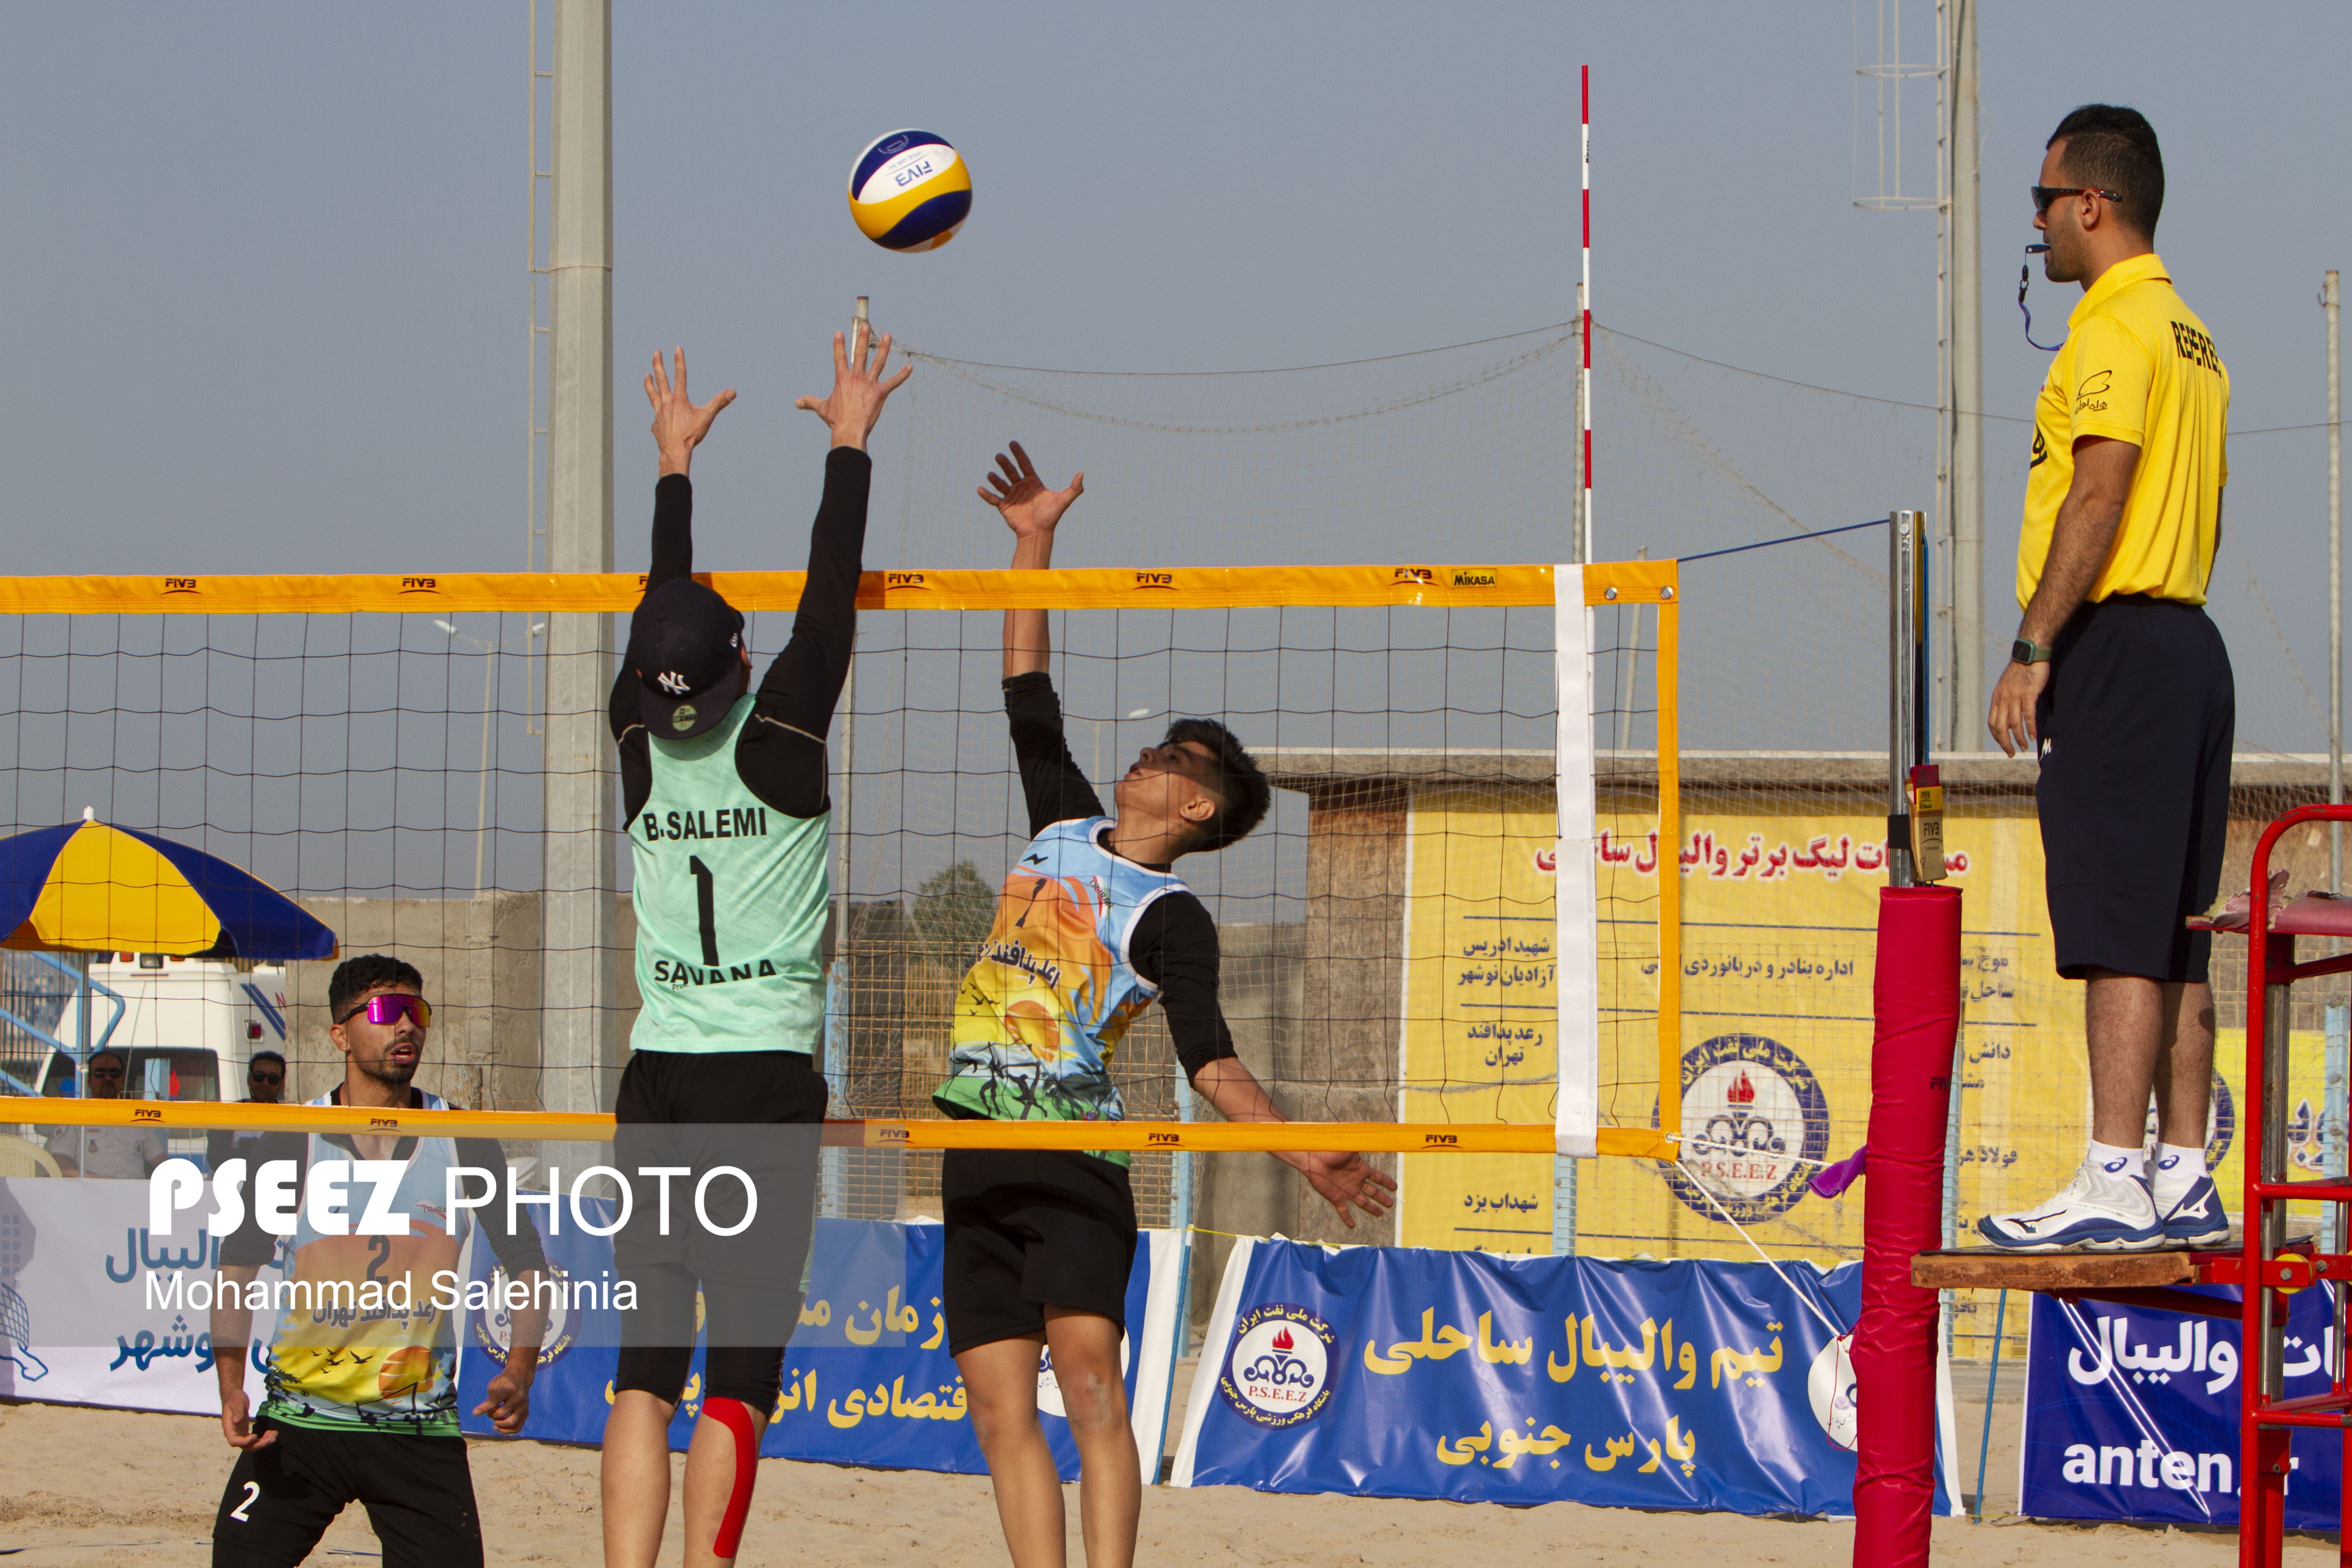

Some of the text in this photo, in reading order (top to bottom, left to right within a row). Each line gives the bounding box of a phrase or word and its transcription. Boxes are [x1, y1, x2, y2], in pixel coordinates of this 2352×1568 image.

[166, 578, 196, 588] FIVB
[402, 578, 436, 588] FIVB
[888, 573, 924, 583] FIVB
[1137, 573, 1172, 583] FIVB
[1394, 568, 1432, 579] FIVB
[643, 807, 767, 842] B.SALEMI
[1924, 822, 1940, 837] FIVB
[1732, 835, 1787, 877] برتر
[1793, 835, 1849, 877] لیگ
[689, 855, 720, 967] 1
[1463, 936, 1550, 957] شهید ادریس
[654, 959, 778, 986] SAVANA
[1457, 964, 1556, 988] آزادیان نوشهر
[1684, 955, 1762, 978] دریانوردی
[1765, 963, 1774, 978] و
[1777, 957, 1812, 979] بنادر
[1816, 959, 1853, 980] اداره
[1467, 1021, 1543, 1046] رعد پدافند
[1485, 1045, 1524, 1067] تهران
[1969, 1042, 2011, 1064] دانش
[134, 1109, 162, 1118] FIVB
[370, 1118, 398, 1127] FIVB
[880, 1129, 910, 1138] FIVB
[1149, 1133, 1180, 1142] FIVB
[1426, 1135, 1457, 1143] FIVB
[1464, 1192, 1539, 1213] شهداب یزد
[105, 1227, 220, 1284] الیبال
[366, 1235, 390, 1285] 2
[1238, 1303, 1335, 1343] شرکت ملی نفت ایران
[109, 1313, 216, 1373] وشهر
[1363, 1306, 1784, 1390] تیم والیبال ساحلی
[2068, 1316, 2239, 1395] والیبال
[1220, 1377, 1238, 1400] جنوبی
[1248, 1385, 1307, 1402] P.S.E.E.Z
[827, 1375, 968, 1428] قتصادی
[1235, 1401, 1256, 1419] پارس
[1313, 1389, 1330, 1411] باشگاه
[1255, 1412, 1286, 1426] ورزشی
[1436, 1415, 1696, 1478] پارس جنوبی
[230, 1481, 260, 1522] 2
